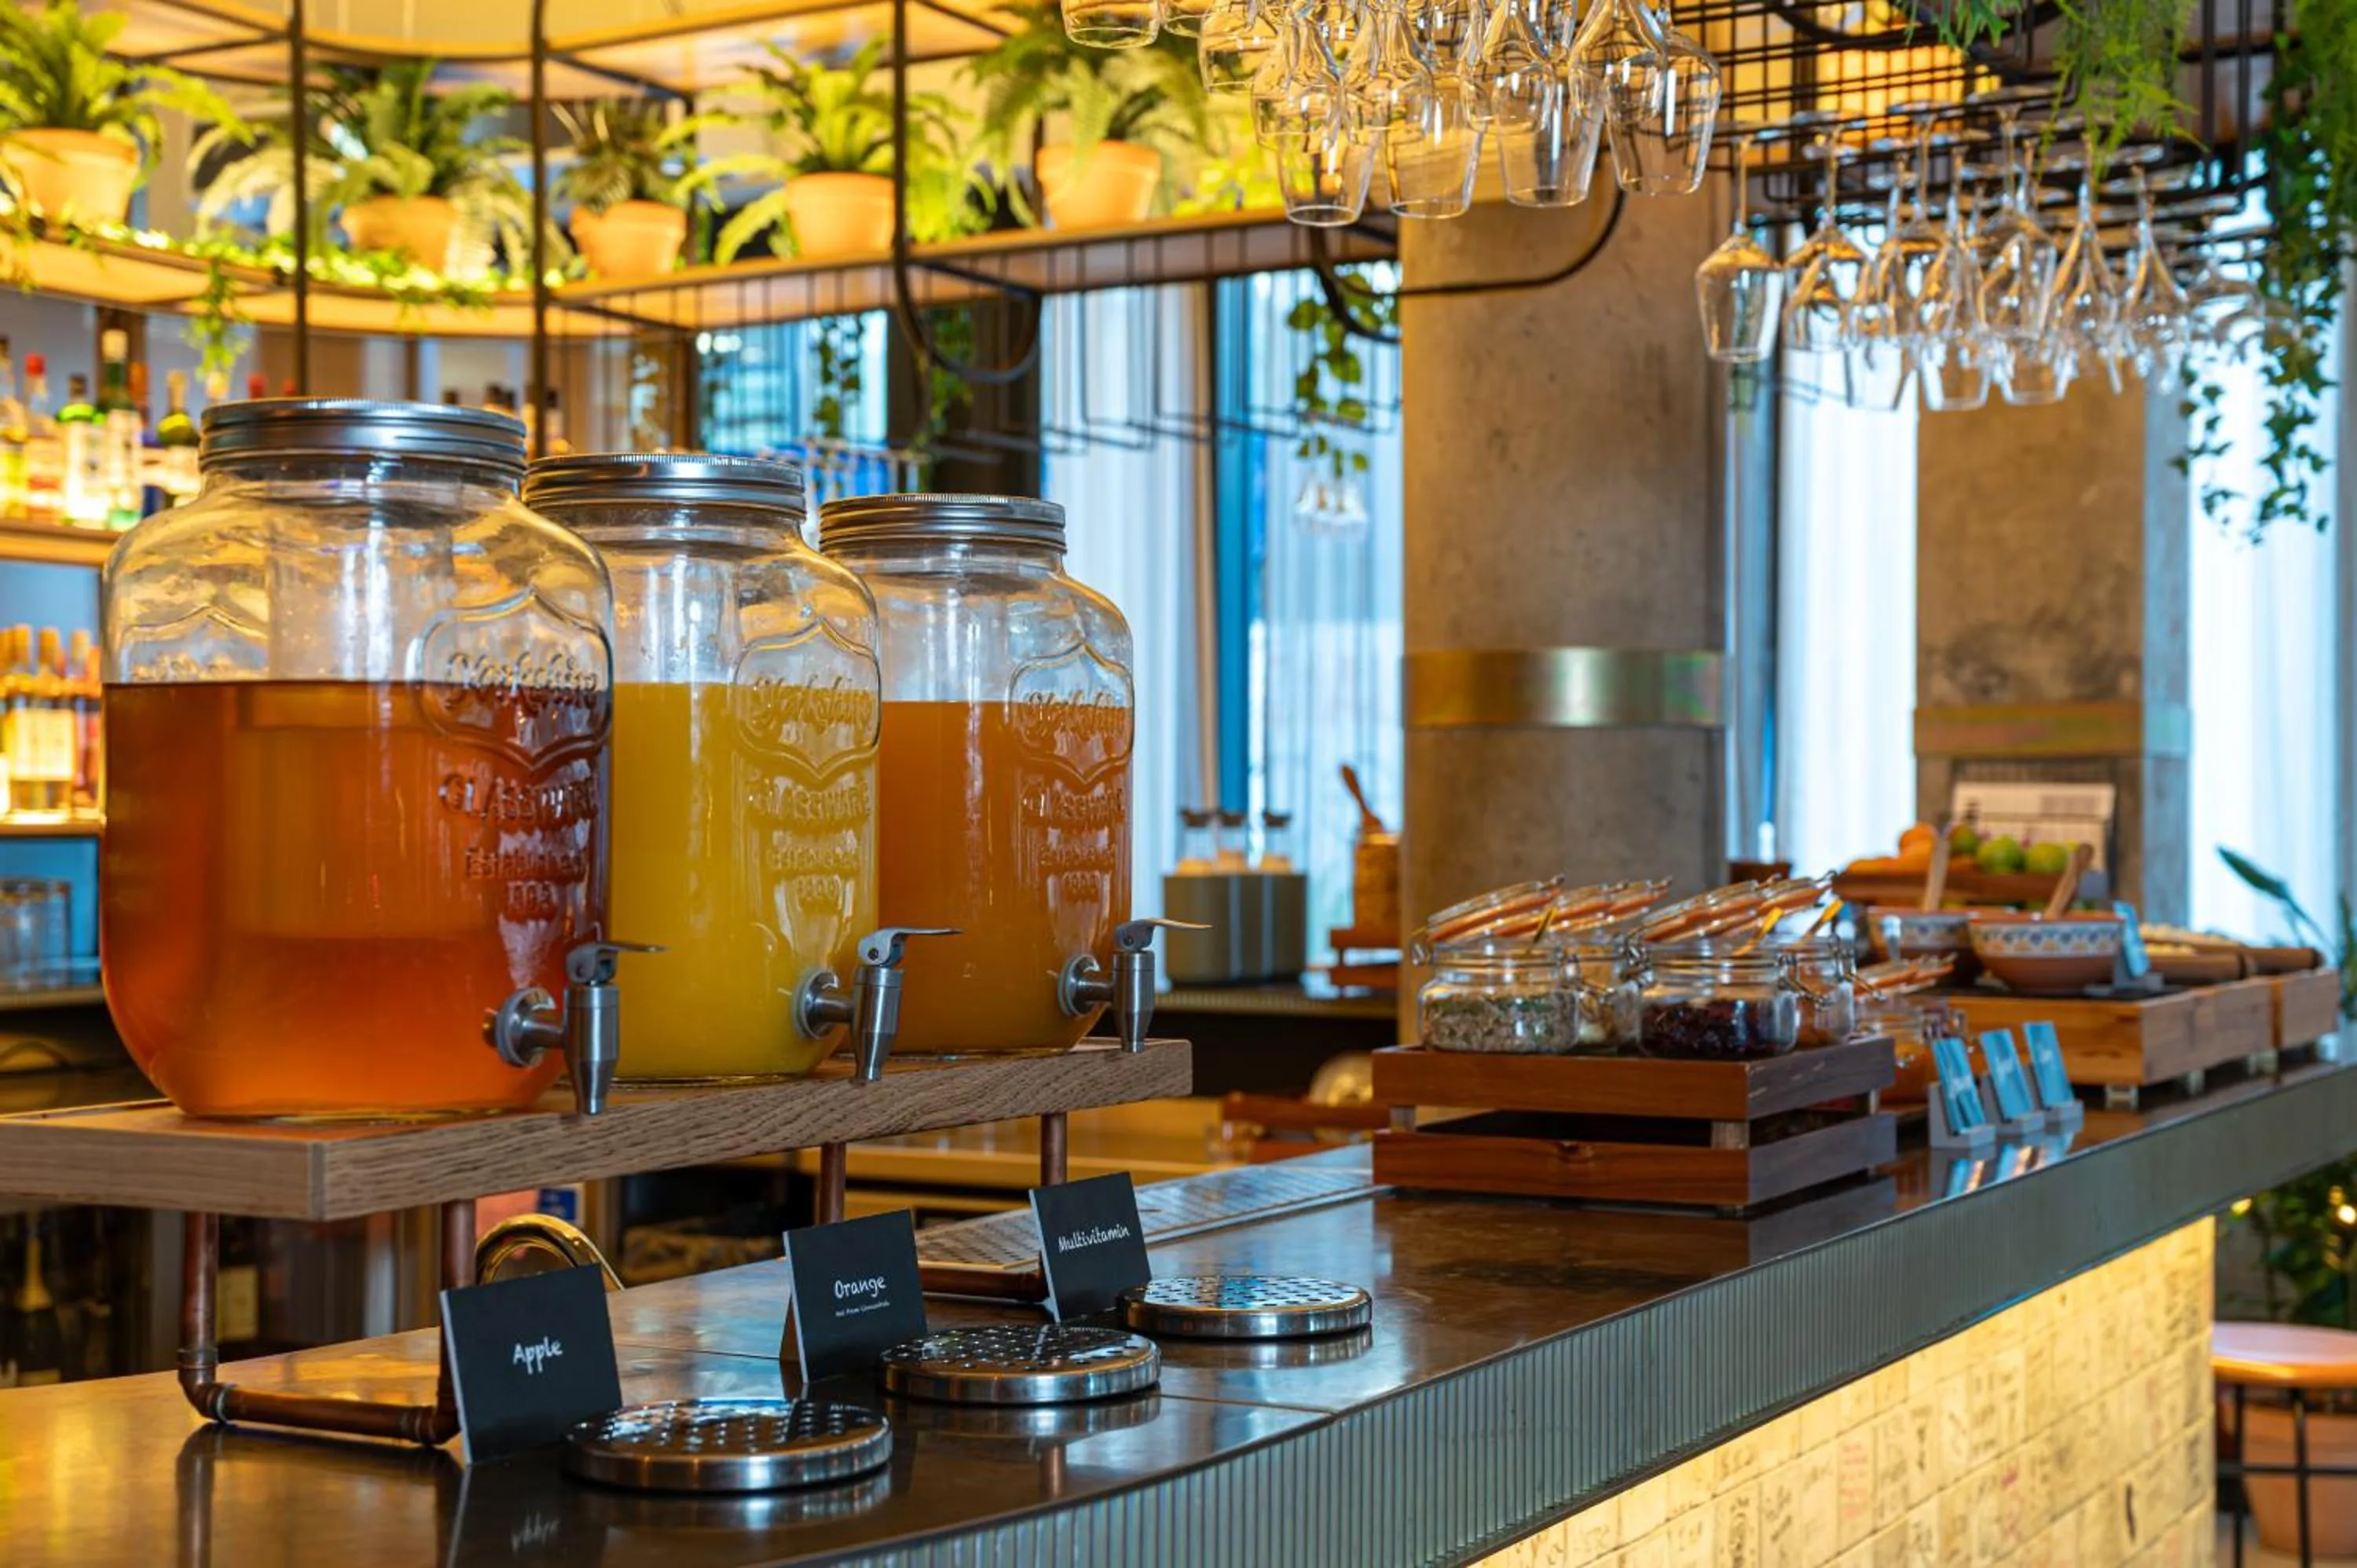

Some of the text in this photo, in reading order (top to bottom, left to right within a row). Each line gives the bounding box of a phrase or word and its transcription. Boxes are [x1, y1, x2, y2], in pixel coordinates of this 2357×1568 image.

[1058, 1223, 1131, 1253] Multivitamin
[834, 1276, 887, 1299] Orange
[512, 1335, 563, 1375] Apple
